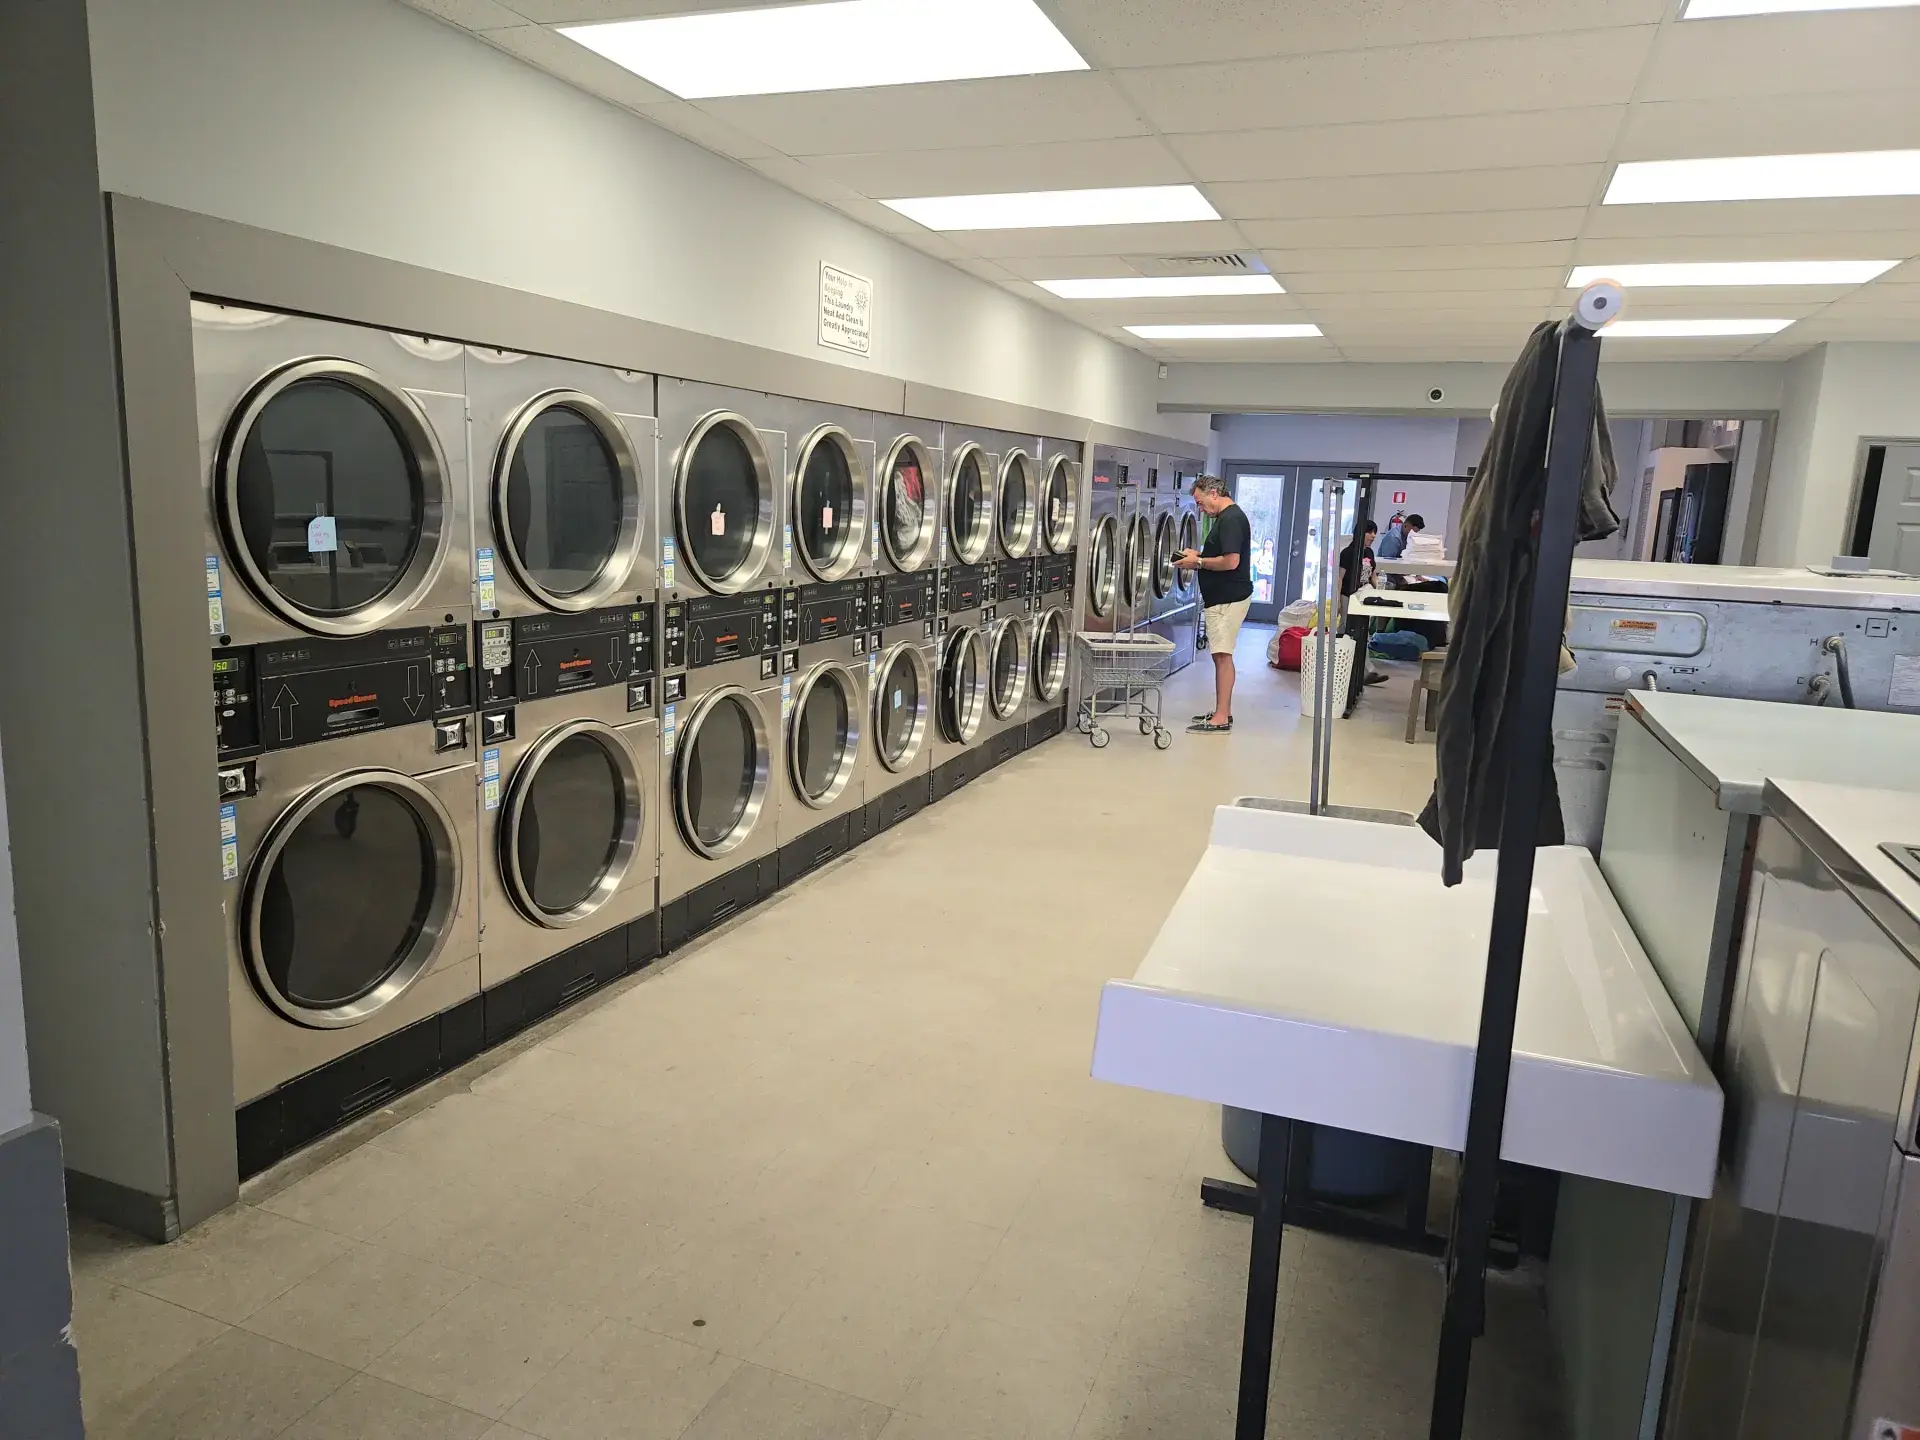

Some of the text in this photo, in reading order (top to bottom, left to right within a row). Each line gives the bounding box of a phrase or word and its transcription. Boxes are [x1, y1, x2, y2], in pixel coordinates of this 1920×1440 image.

[824, 270, 836, 282] Your
[824, 294, 854, 314] This Laundry
[824, 306, 835, 317] Neat
[836, 310, 844, 321] And
[845, 314, 859, 325] Clean
[823, 318, 868, 339] Greatly Appreciated
[482, 589, 494, 600] 20
[211, 606, 220, 621] 8
[1796, 676, 1804, 684] C
[328, 693, 377, 708] Speed Queen
[226, 851, 235, 865] 9
